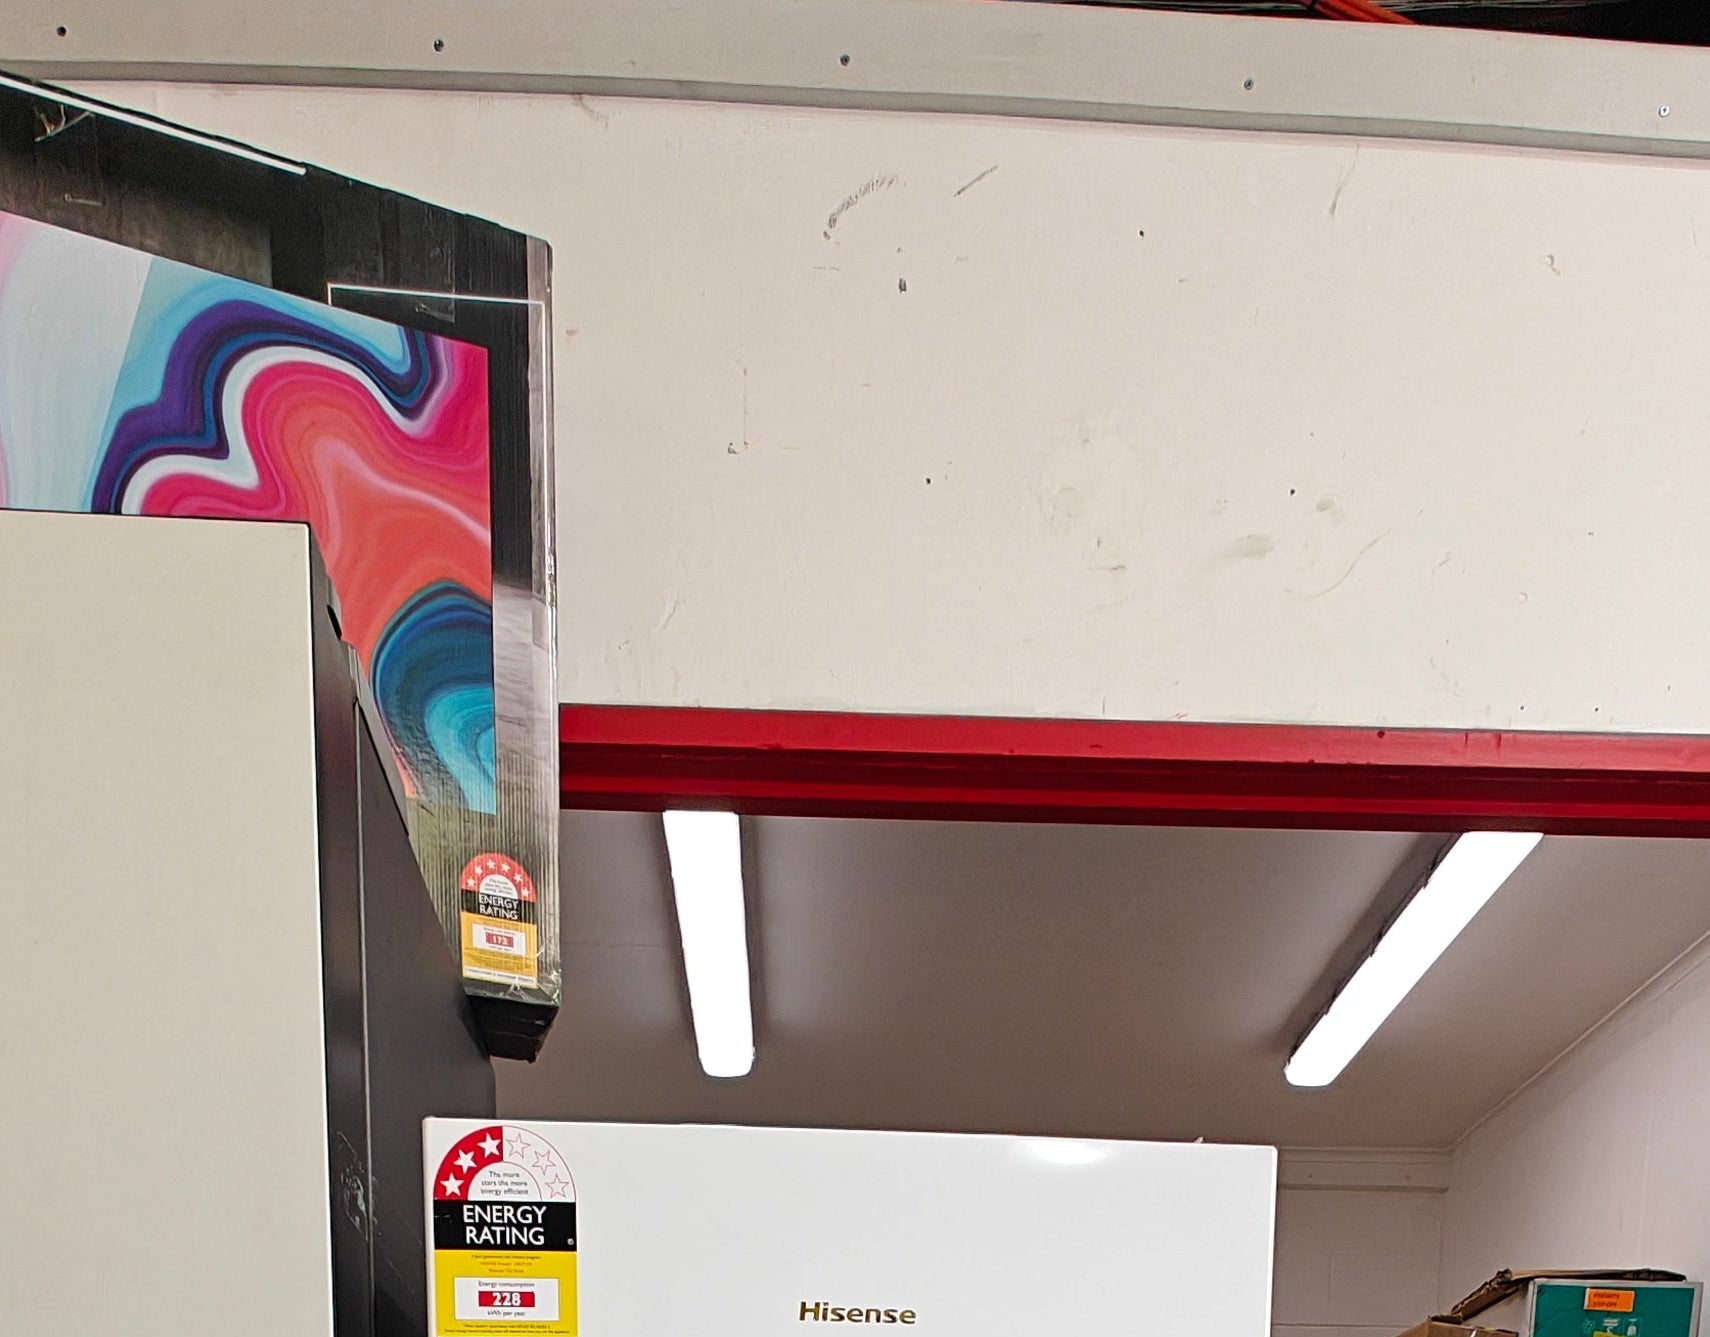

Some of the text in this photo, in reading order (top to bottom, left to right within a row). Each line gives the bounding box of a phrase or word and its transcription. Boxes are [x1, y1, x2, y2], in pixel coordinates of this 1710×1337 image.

[479, 894, 519, 909] ENERGY
[479, 904, 518, 920] RATING
[463, 1204, 547, 1224] ENERGY
[465, 1226, 545, 1246] RATING
[478, 1281, 498, 1289] Energy
[492, 1292, 522, 1307] 228
[799, 1301, 917, 1325] Hisense
